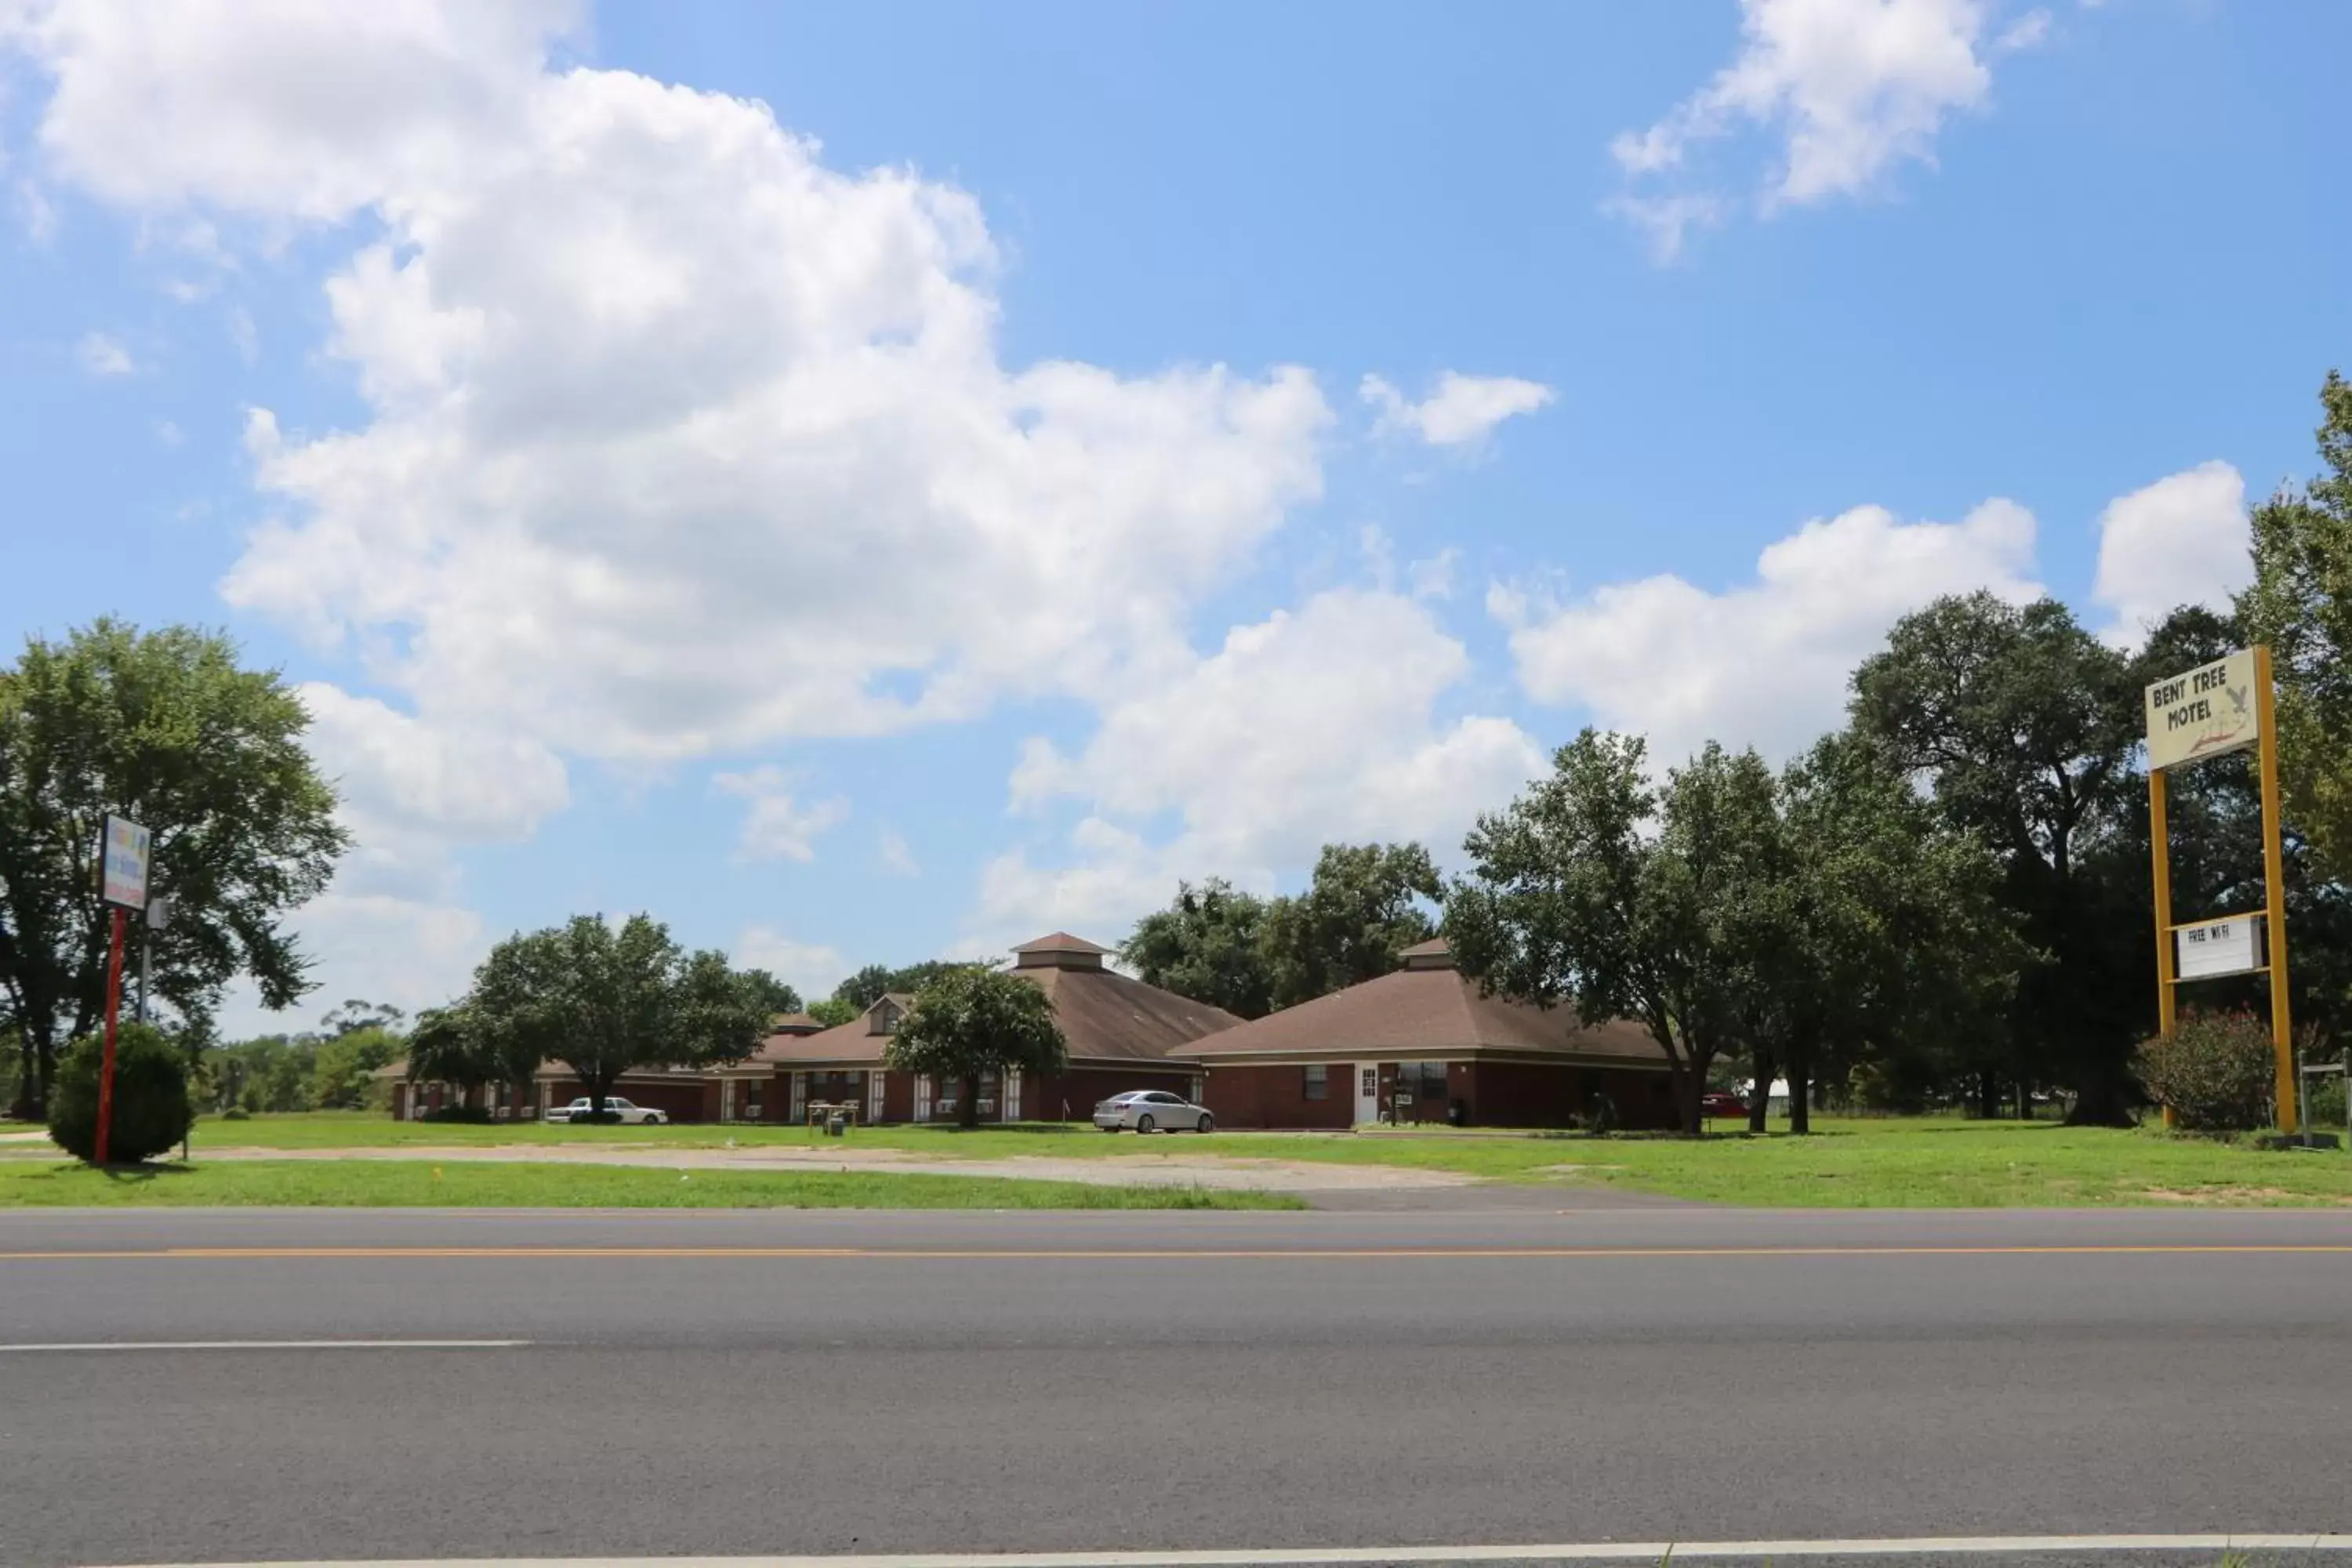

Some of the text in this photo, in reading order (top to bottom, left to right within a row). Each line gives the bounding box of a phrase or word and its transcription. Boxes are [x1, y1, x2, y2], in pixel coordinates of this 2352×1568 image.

[2153, 665, 2226, 709] BENT TREE
[2168, 699, 2212, 731] MOTEL
[2188, 928, 2205, 943] FREE
